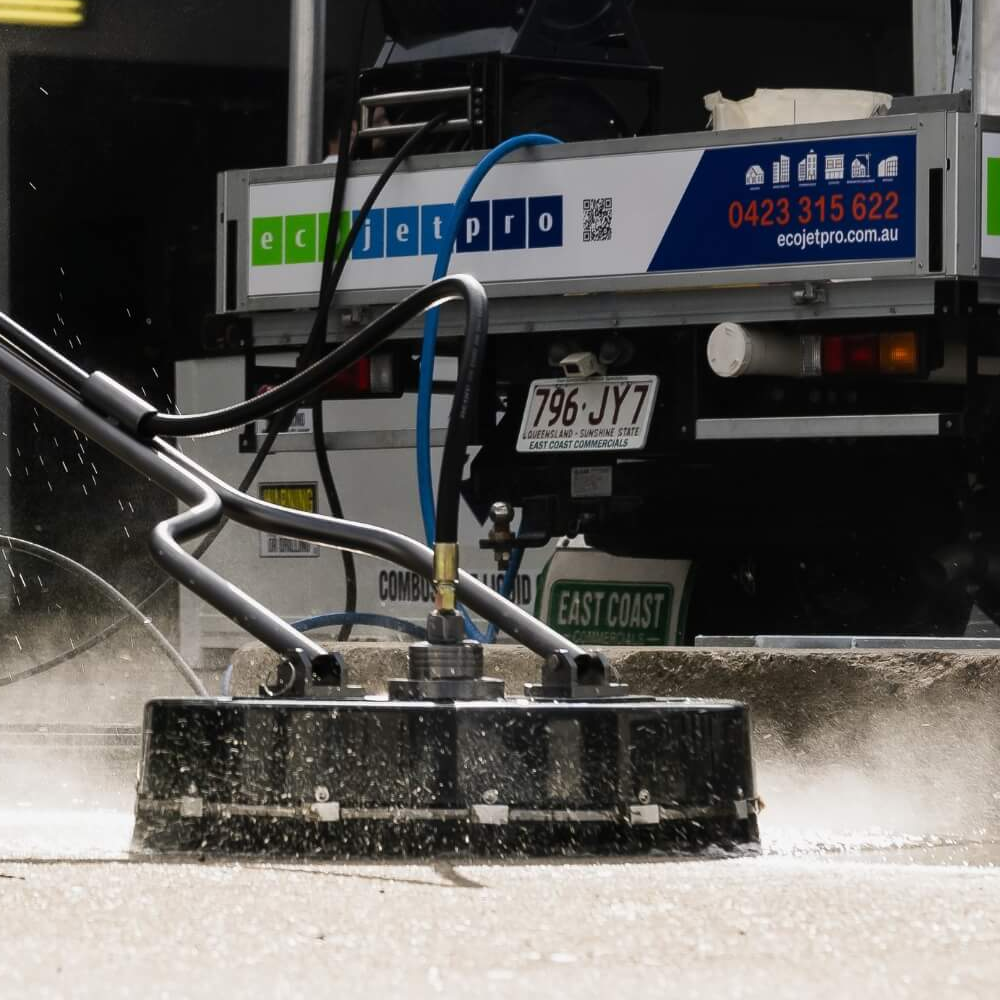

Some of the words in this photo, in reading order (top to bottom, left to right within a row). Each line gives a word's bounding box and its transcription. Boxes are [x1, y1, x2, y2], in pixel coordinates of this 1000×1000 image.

[728, 197, 791, 229] 0423
[797, 193, 845, 225] 315
[852, 190, 899, 221] 622
[260, 211, 553, 251] ecjetpro
[777, 227, 899, 250] ecojetpro.com.au
[527, 429, 573, 440] QUEENSLAND
[579, 428, 615, 438] SUNSHINE
[617, 426, 640, 437] STATE
[529, 440, 547, 449] EAST
[549, 439, 572, 449] COAST
[573, 438, 628, 449] COMMERCIALS
[558, 590, 604, 626] EAST
[607, 591, 665, 628] COAST
